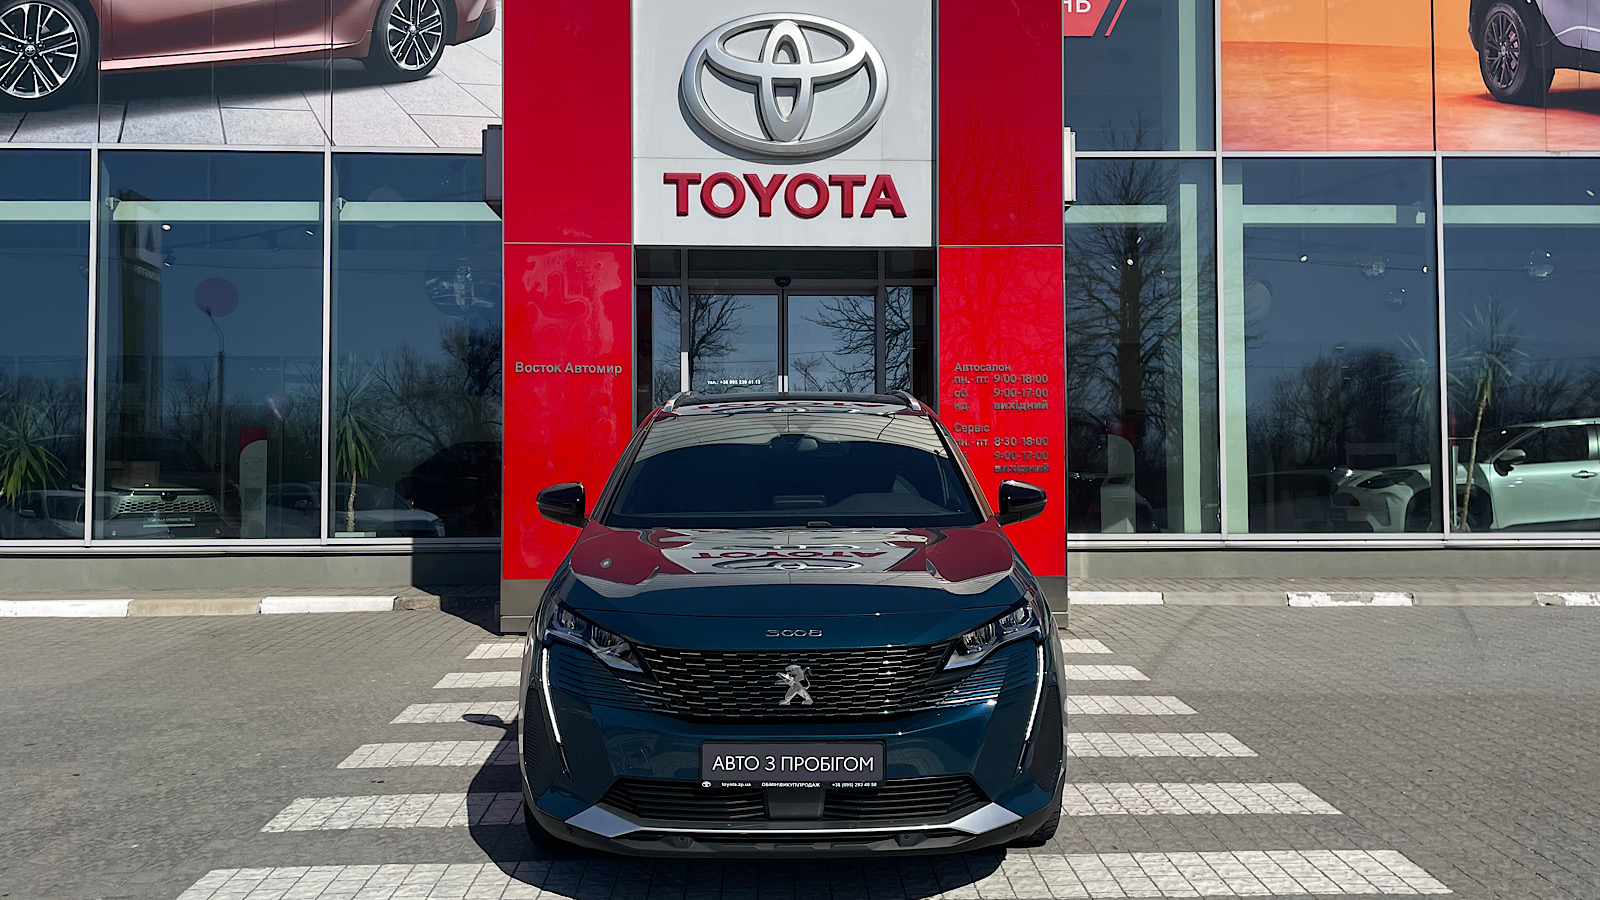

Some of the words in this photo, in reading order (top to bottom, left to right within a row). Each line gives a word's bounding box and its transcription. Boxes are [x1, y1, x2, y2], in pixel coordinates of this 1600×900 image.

[663, 172, 908, 219] TOYOTA
[515, 361, 562, 374] Восток
[564, 362, 623, 377] Автомир
[954, 362, 1011, 373] Автосалон
[993, 373, 1049, 384] 9:00-18:00
[993, 388, 1049, 398] 9:00-17:00
[993, 400, 1049, 412] вихідний
[954, 422, 990, 434] Сервіс
[994, 451, 1049, 461] 9:00-17:00
[994, 462, 1050, 474] вихідний
[765, 629, 823, 637] 3008
[712, 755, 760, 771] АВТО
[764, 756, 776, 772] З
[781, 756, 874, 772] ПРОБІГОМ
